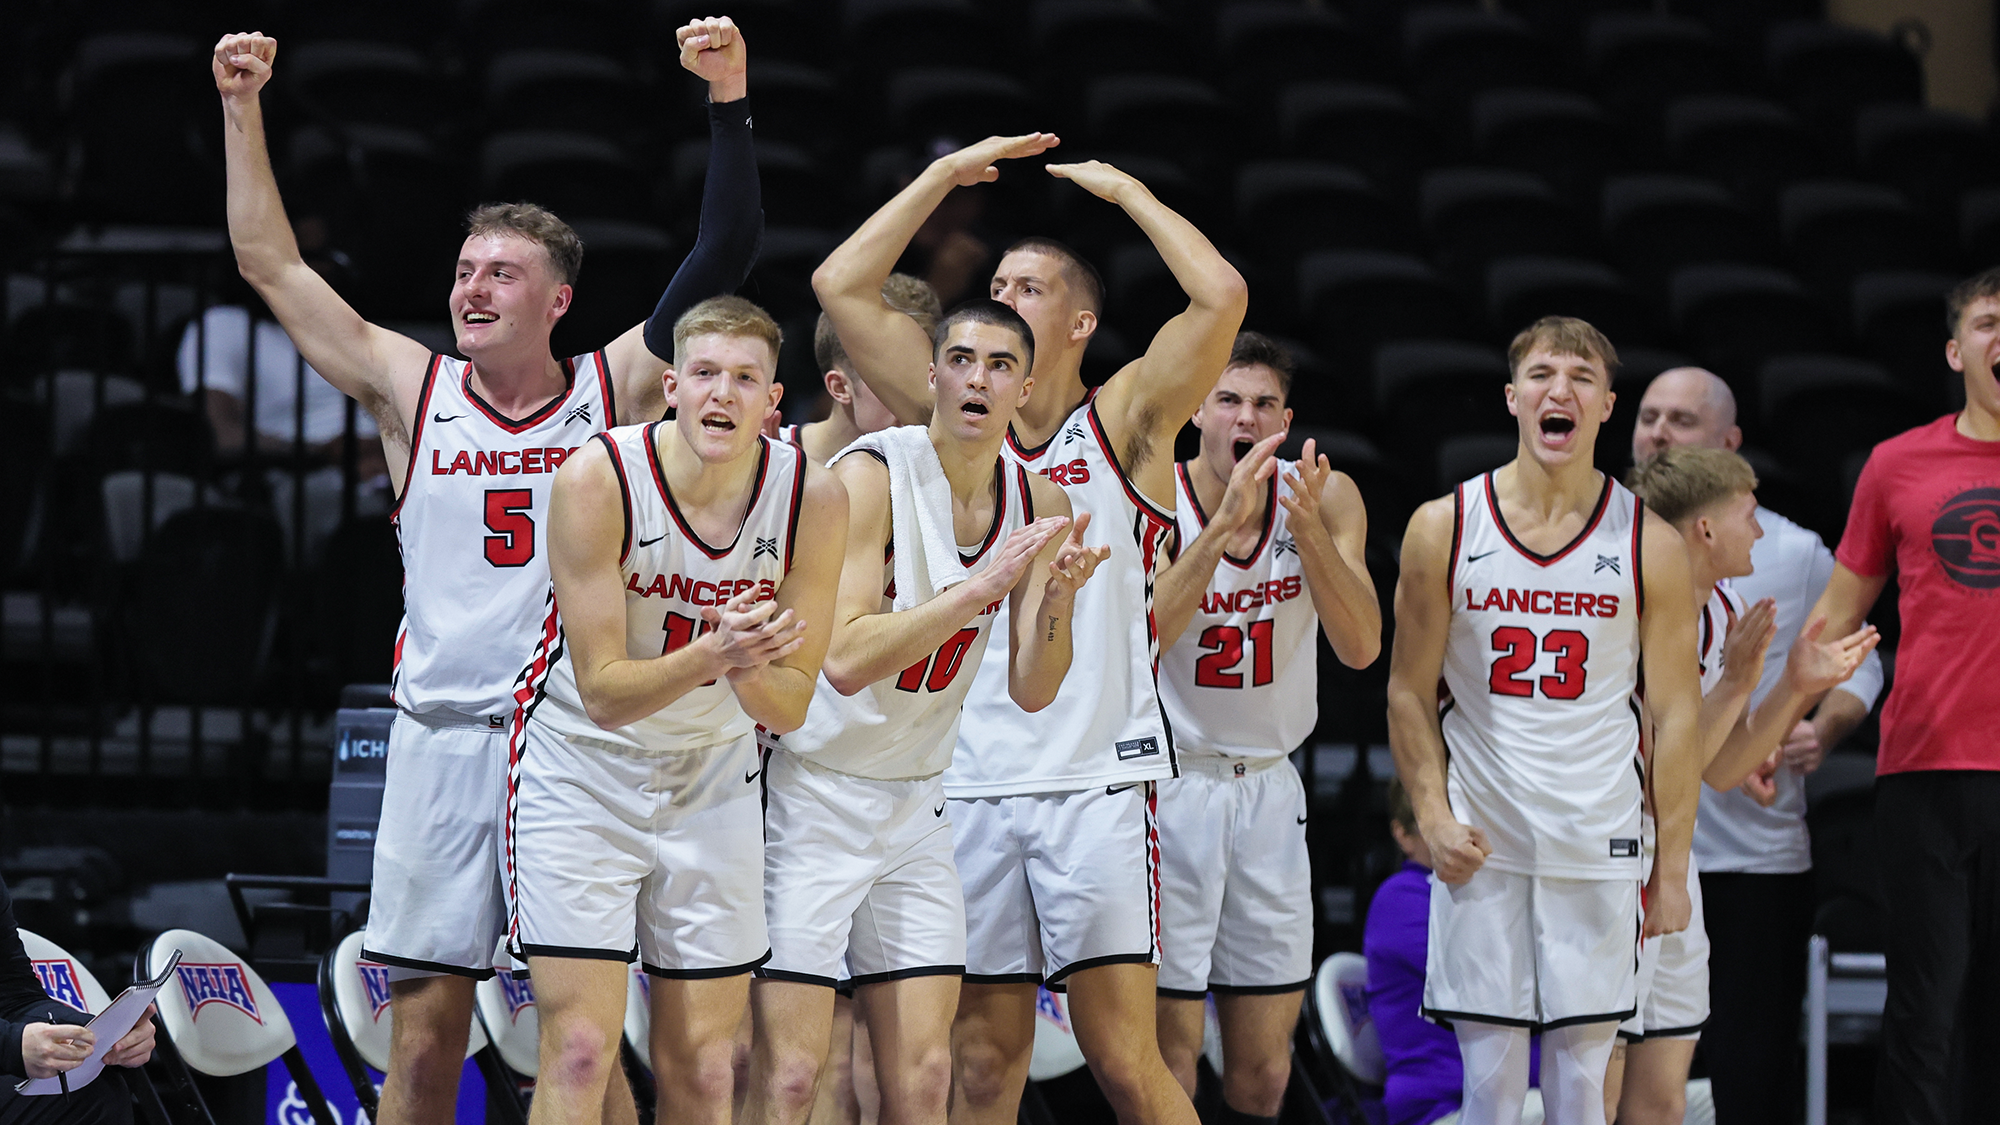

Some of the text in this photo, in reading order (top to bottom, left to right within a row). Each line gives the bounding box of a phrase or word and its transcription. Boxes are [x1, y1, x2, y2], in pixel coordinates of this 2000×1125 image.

[483, 488, 535, 567] 5
[1466, 587, 1620, 618] LANCERS
[1195, 618, 1274, 689] 21
[1489, 626, 1589, 700] 23
[351, 740, 389, 758] ICH
[1143, 742, 1154, 750] XL
[177, 966, 256, 1015] NAIA
